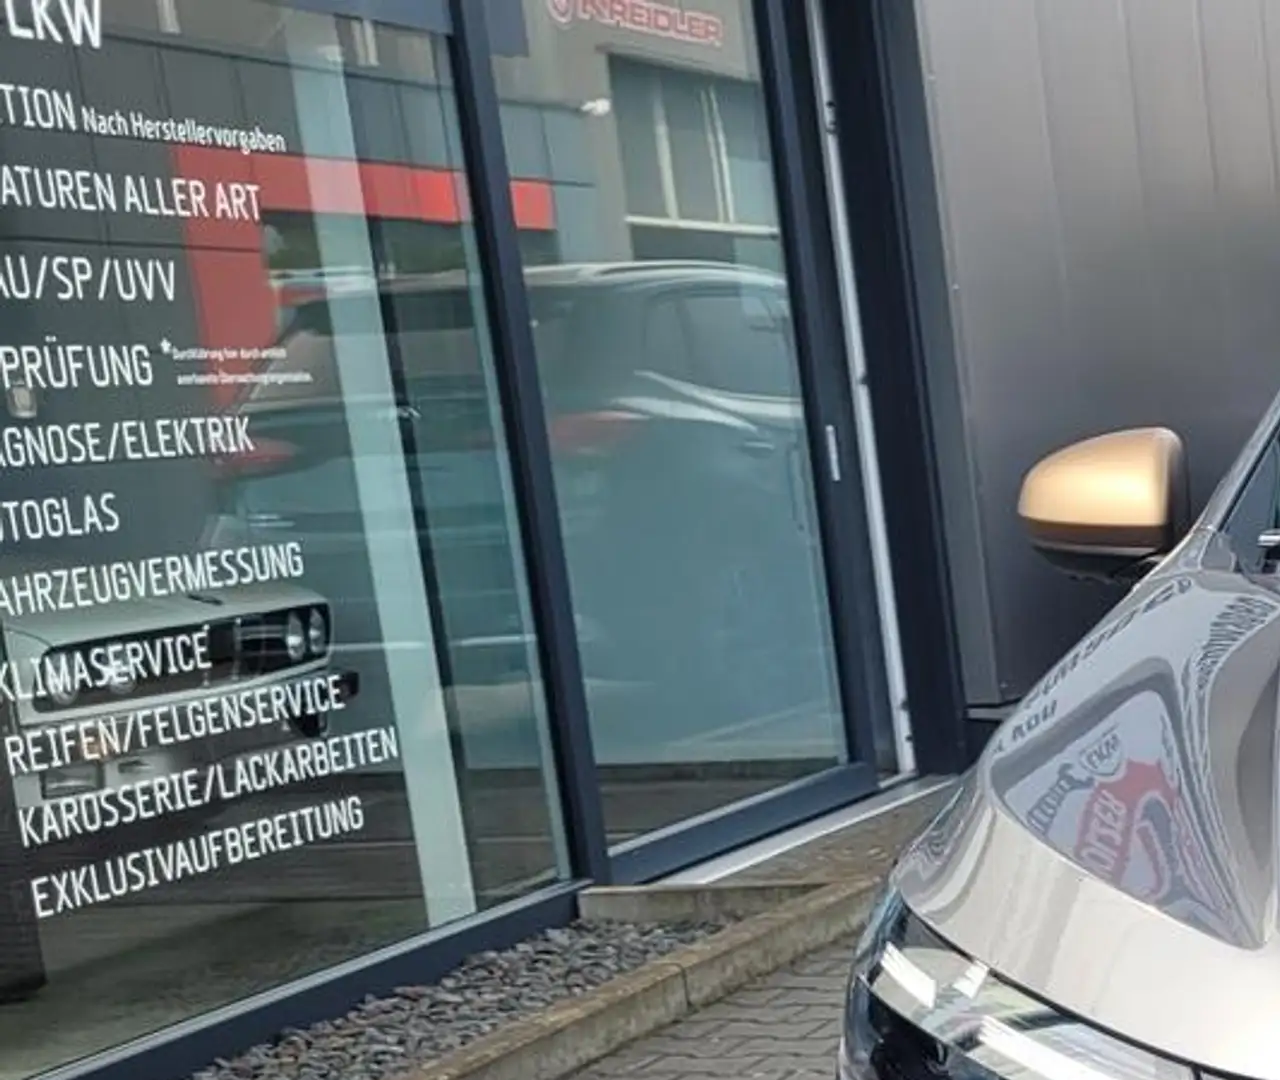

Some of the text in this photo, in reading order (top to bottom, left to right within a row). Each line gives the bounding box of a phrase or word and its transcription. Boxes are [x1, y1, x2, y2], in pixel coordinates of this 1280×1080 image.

[4, 0, 101, 48] LKW
[0, 84, 287, 155] TION Nach Herstellervorgaben
[0, 165, 261, 221] ATUREN ALLER ART
[0, 335, 153, 389] PRÜFUNG
[0, 416, 254, 468] GNOSE/ELEKTRIK
[0, 493, 120, 542] TOGLAS
[4, 675, 346, 776] REIFEN/FELGENSERVICE
[18, 726, 398, 848] KAROSSERIE/LACKARBEITEN
[31, 796, 364, 918] EXKLUSIVAUFBEREITUNG
